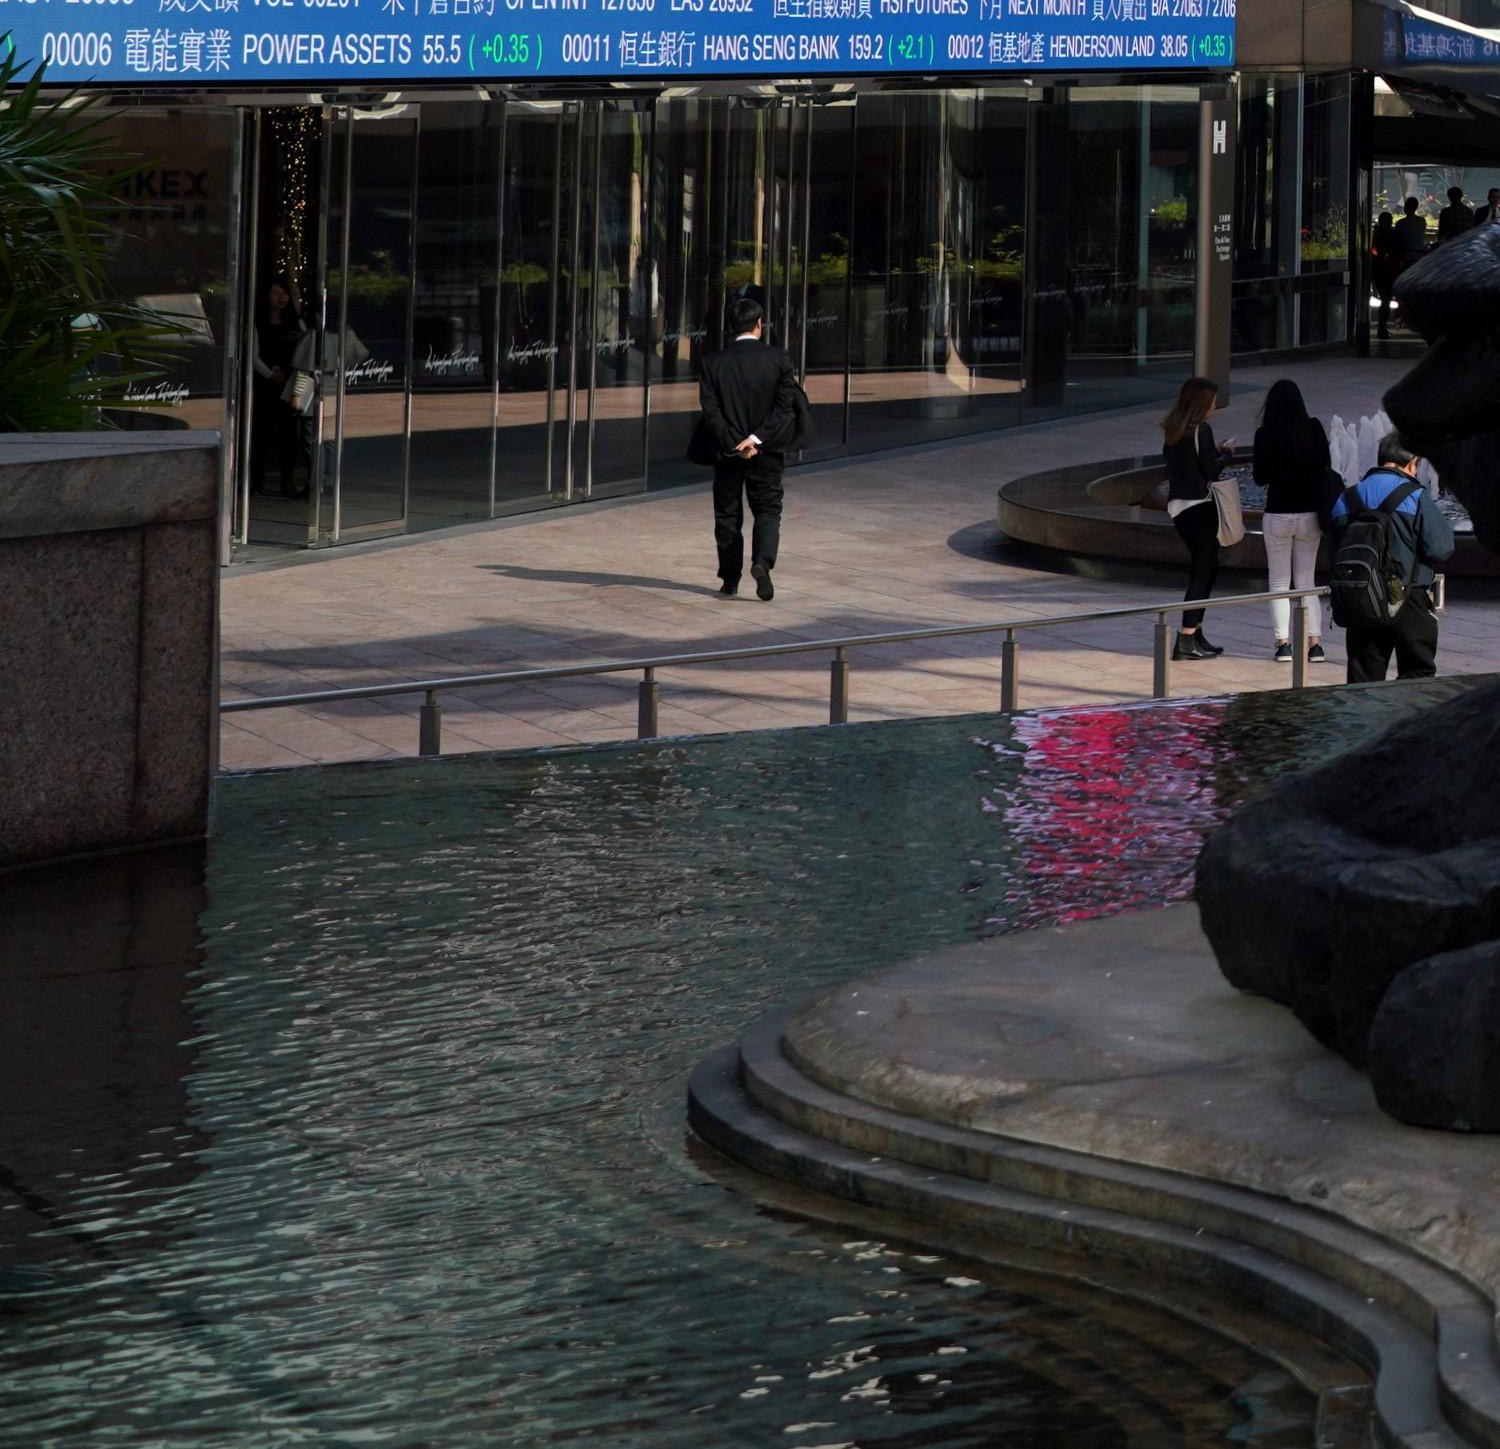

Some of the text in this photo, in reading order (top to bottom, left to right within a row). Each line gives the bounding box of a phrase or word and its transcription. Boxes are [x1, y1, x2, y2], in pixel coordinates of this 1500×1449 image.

[43, 32, 112, 66] 00006
[124, 28, 231, 72] 電能實業
[243, 33, 324, 64] POWER
[329, 34, 411, 64] ASSETS
[423, 35, 460, 63] 55.5
[563, 34, 609, 62] 00011
[619, 31, 695, 67] 恒生銀行
[704, 35, 748, 60] HANG
[753, 35, 795, 60] SENG
[800, 35, 839, 59] BANK
[849, 35, 882, 59] 159.2
[948, 35, 983, 58] 00012
[989, 32, 1044, 62] 恒基地產
[1051, 35, 1123, 57] HENDERSON
[1126, 36, 1154, 56] LAND
[1161, 35, 1187, 56] 38.05
